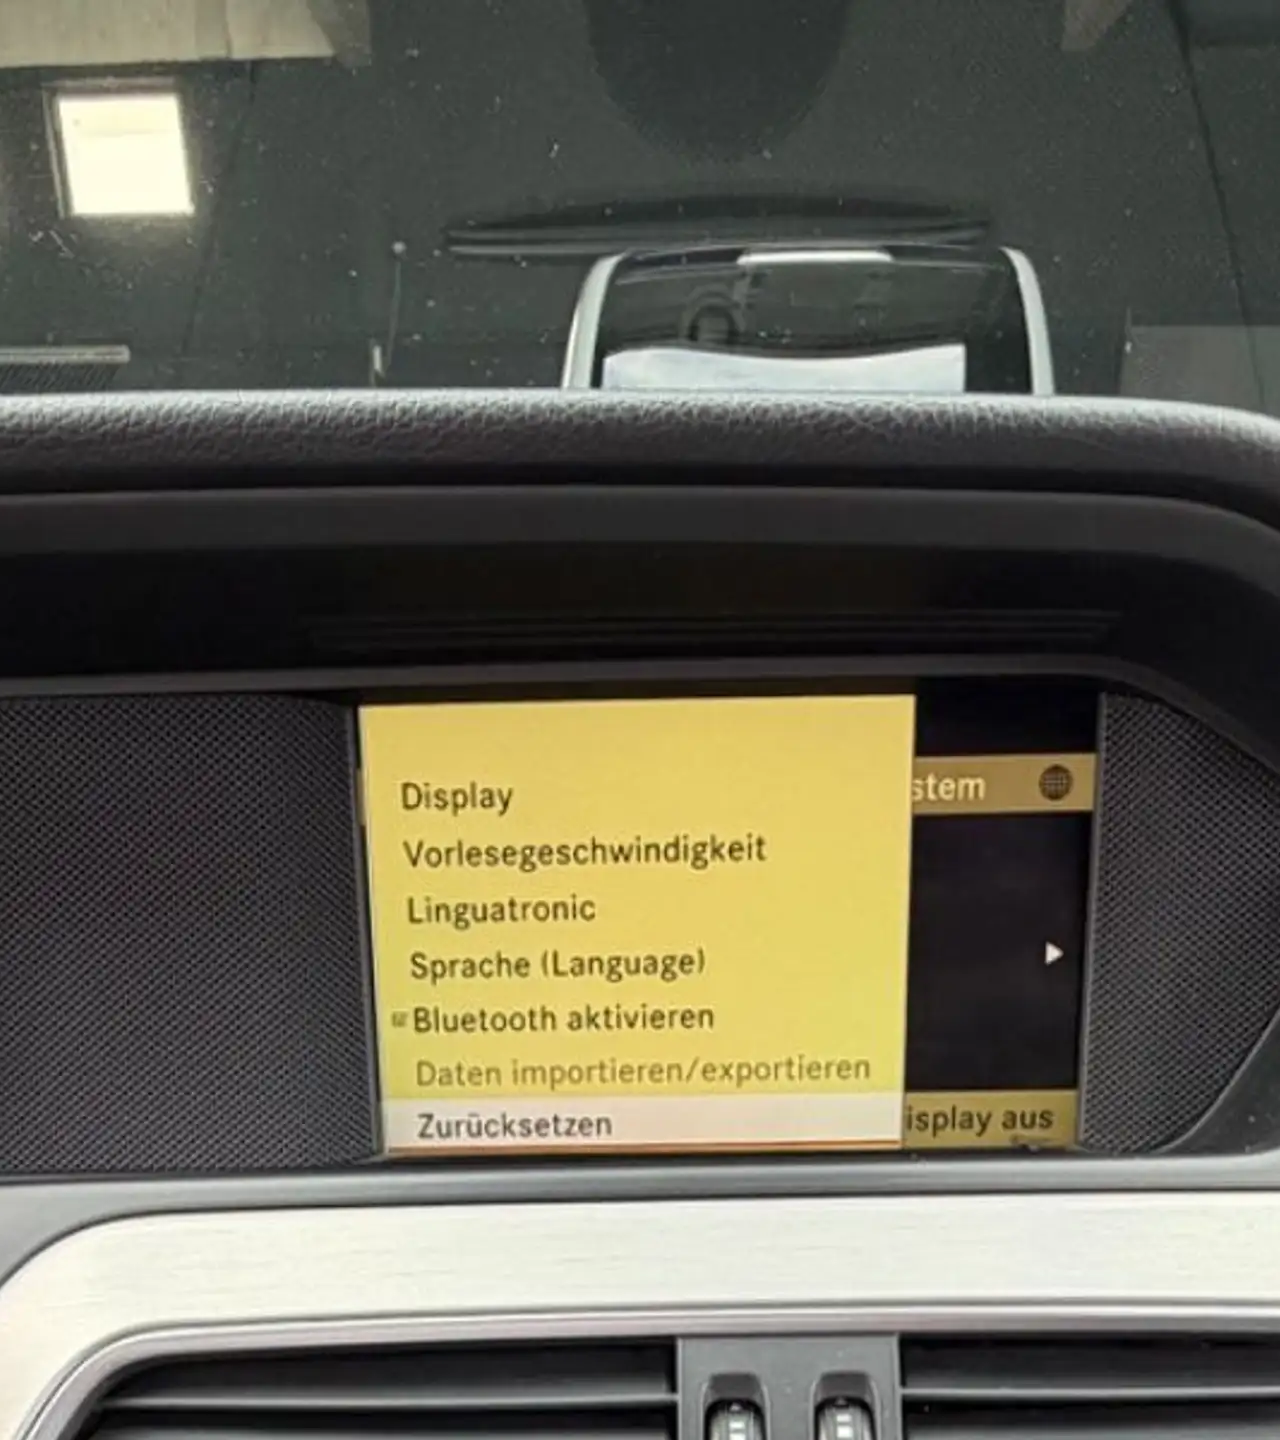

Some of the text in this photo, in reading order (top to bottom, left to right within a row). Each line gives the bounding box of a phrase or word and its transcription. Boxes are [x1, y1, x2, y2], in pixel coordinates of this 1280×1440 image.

[401, 781, 513, 816] Display
[912, 773, 985, 801] stem
[404, 834, 767, 872] Vorlesegeschwindigkeit
[407, 895, 596, 931] Linguatronic
[410, 948, 706, 986] Sprache (Language)
[413, 1002, 715, 1034] Bluetooth aktivieren
[416, 1053, 870, 1087] Daten importieren/exportieren
[418, 1110, 613, 1140] Zurücksetzen
[906, 1104, 1054, 1138] isplay aus
